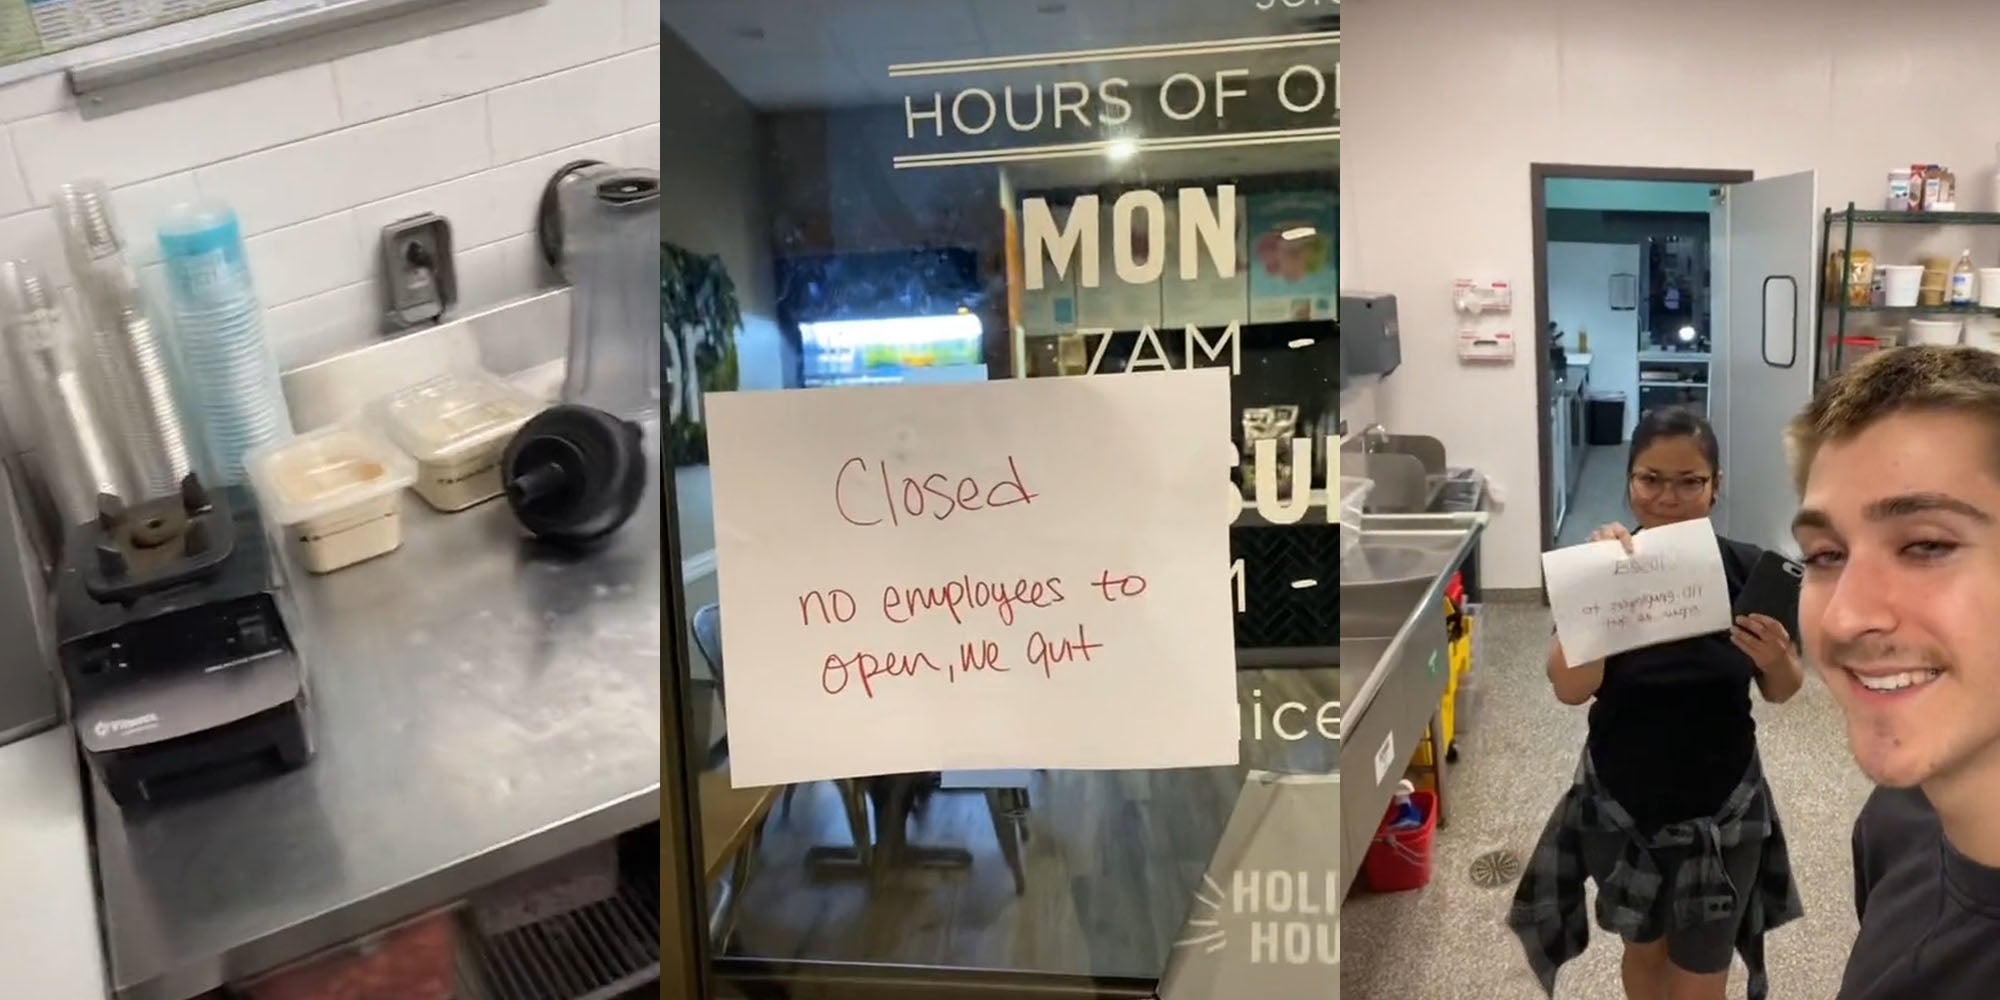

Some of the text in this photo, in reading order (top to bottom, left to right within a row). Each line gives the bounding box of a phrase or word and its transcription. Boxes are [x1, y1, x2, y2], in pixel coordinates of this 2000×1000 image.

[905, 62, 1340, 138] HOURS OF O
[1022, 184, 1237, 290] MON
[1076, 320, 1241, 376] 7AM
[835, 455, 1038, 526] Closed
[799, 570, 1146, 626] no employees to
[822, 624, 1103, 698] open, we quit
[1233, 688, 1340, 741] ice
[1233, 869, 1336, 915] HOLI
[1251, 920, 1340, 965] HOU
